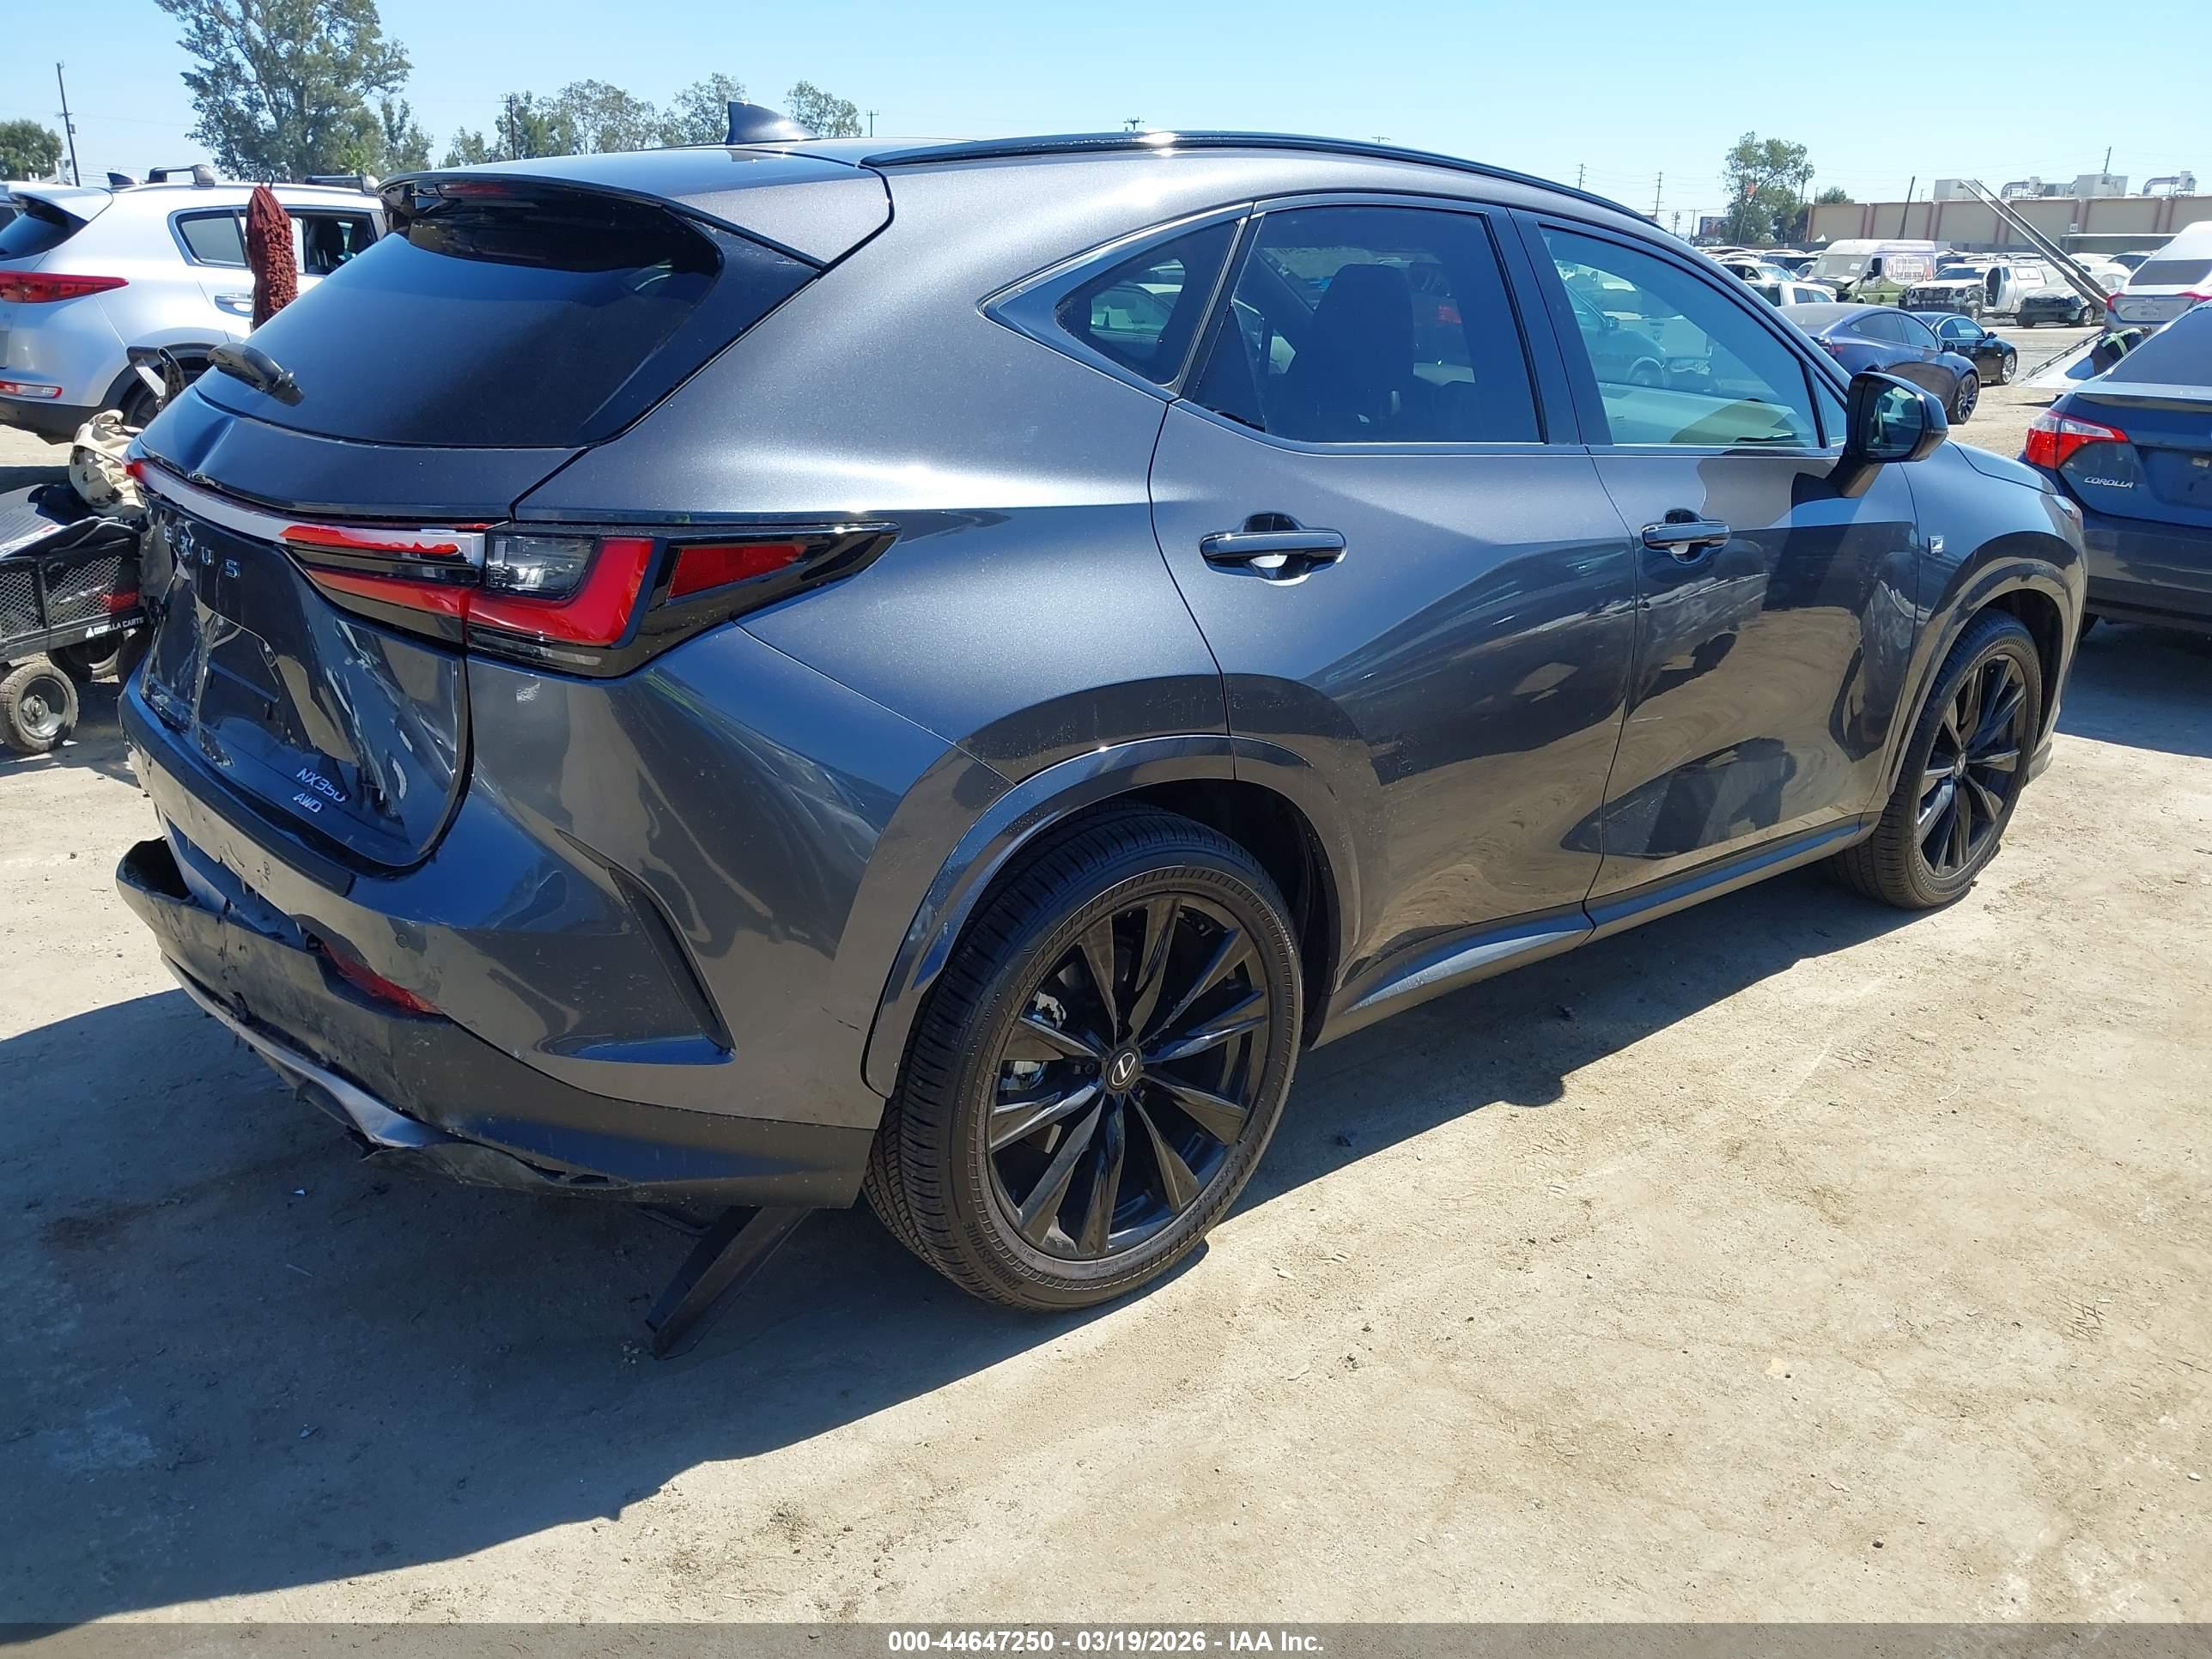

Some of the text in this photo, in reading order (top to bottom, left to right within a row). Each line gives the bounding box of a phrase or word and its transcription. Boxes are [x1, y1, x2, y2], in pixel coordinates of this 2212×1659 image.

[2084, 477, 2134, 489] COROLLA
[94, 617, 143, 635] GORILLA CARTS
[293, 793, 323, 813] AWD
